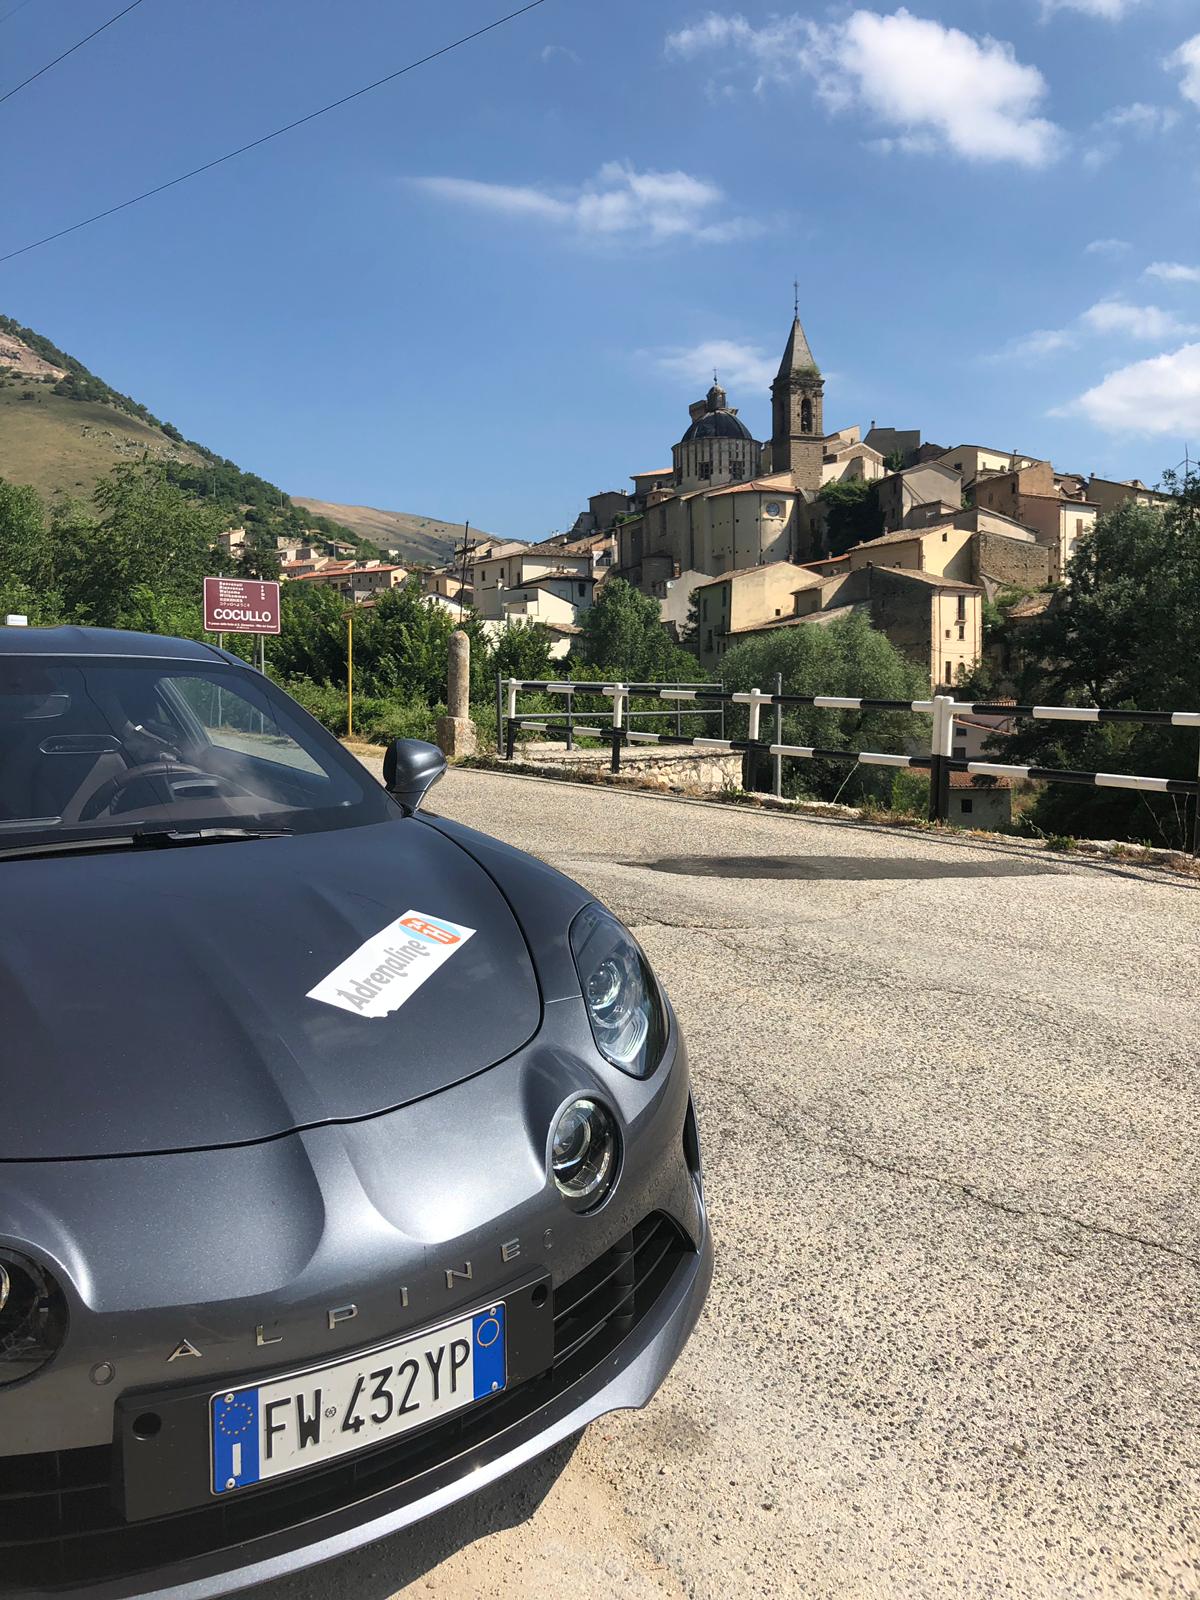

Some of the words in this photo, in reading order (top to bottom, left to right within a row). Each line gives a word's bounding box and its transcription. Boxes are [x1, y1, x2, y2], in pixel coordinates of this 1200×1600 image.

[213, 608, 272, 622] COCULLO
[335, 939, 431, 1011] Adrenaline
[167, 1237, 522, 1362] ALPINE
[264, 1388, 323, 1460] FW
